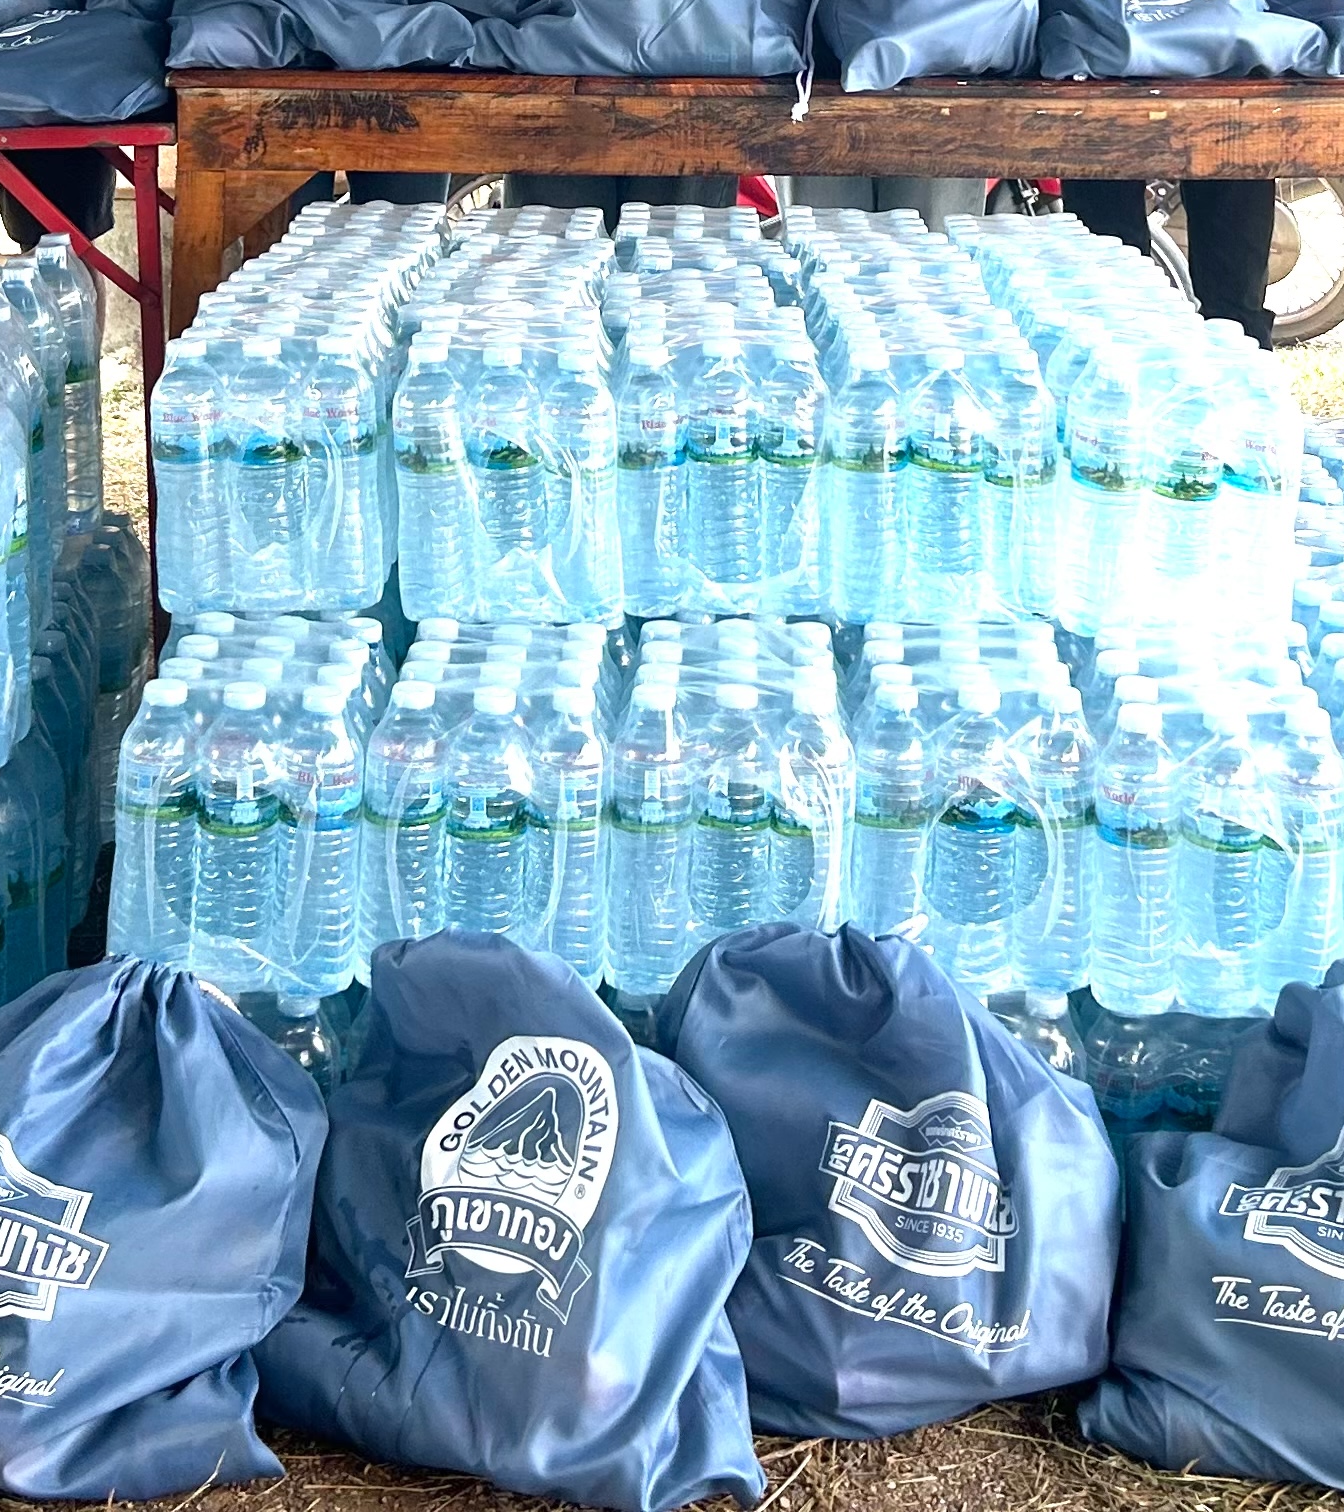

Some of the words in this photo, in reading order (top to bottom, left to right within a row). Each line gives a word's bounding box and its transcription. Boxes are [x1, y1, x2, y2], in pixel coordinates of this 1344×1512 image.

[439, 1048, 533, 1153] GOLDEN
[537, 1047, 609, 1183] MOUNTAIN
[429, 1195, 572, 1261] ภูเขาทอง
[894, 1214, 930, 1234] SINCE
[932, 1221, 965, 1243] 1935
[406, 1284, 555, 1358] เราไม่ทิ้งกัน
[783, 1237, 825, 1275] The
[823, 1258, 870, 1303] Taste
[871, 1289, 905, 1321] of
[902, 1292, 936, 1325] the
[940, 1303, 1031, 1354] Original
[1212, 1275, 1252, 1311] The
[1259, 1286, 1318, 1324] Taste
